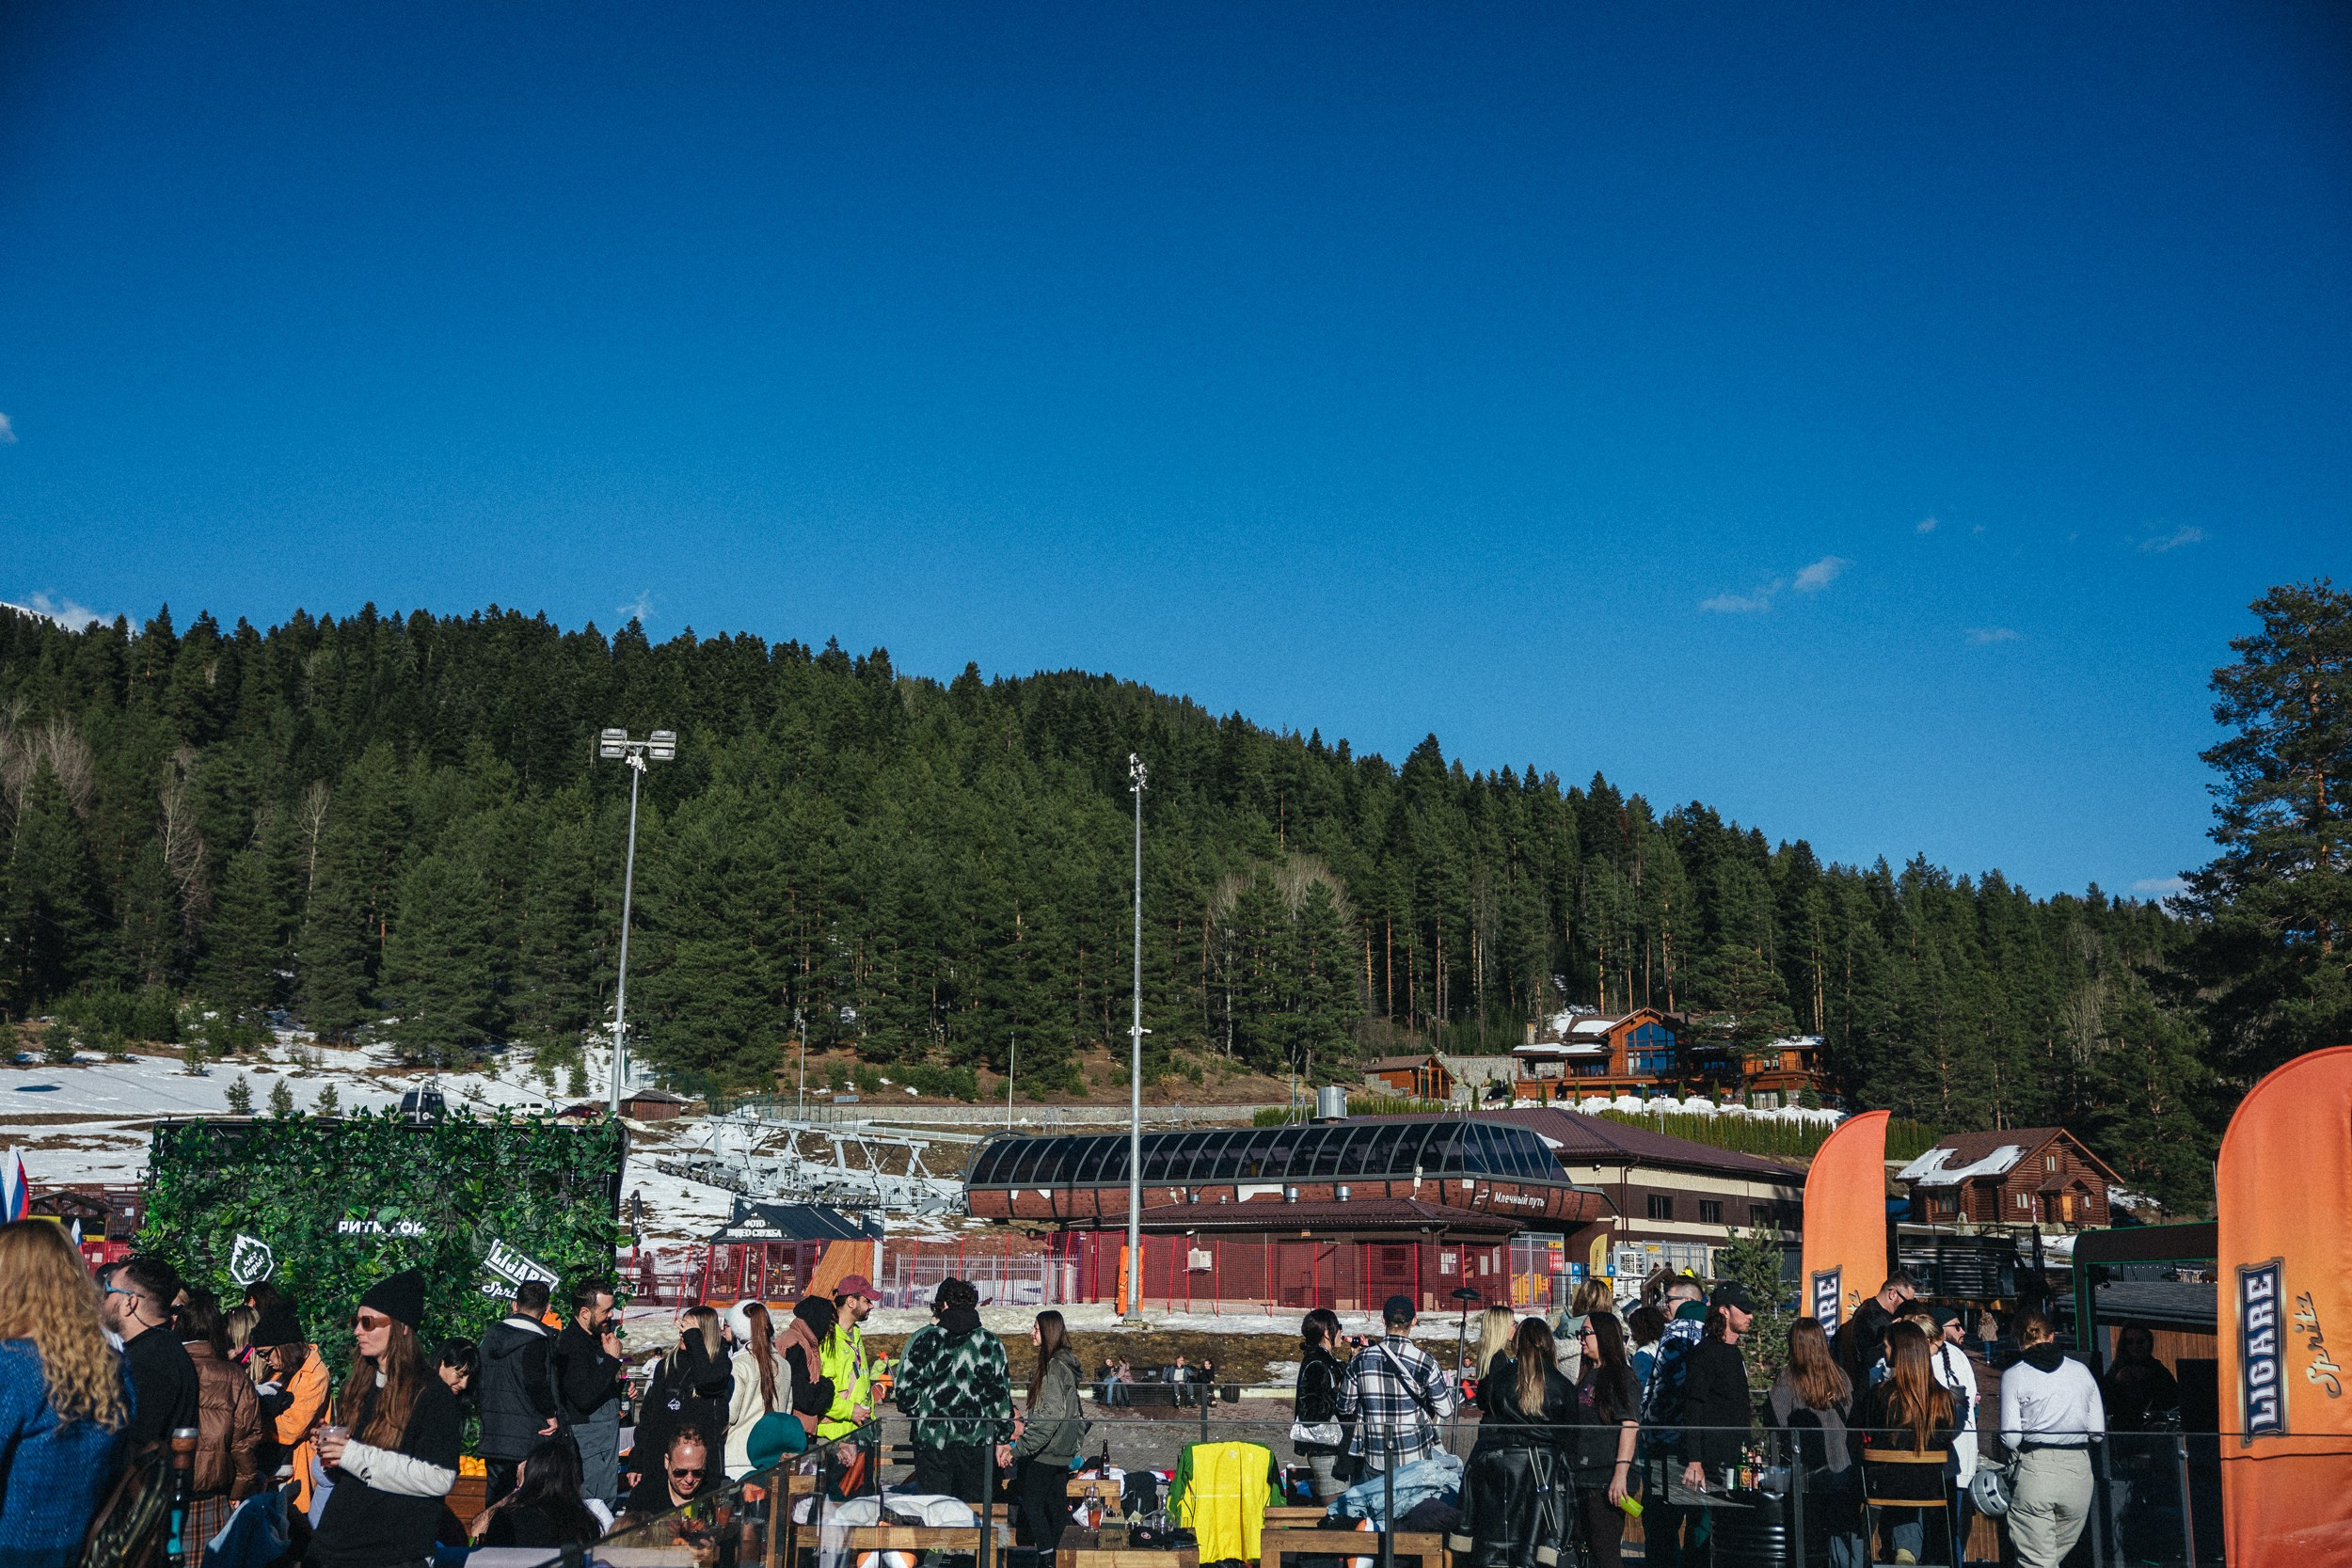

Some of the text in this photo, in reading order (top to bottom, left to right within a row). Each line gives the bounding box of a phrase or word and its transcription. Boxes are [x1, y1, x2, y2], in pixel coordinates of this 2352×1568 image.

[1494, 1192, 1545, 1209] Млечный путь
[743, 1219, 767, 1228] ФОТО
[726, 1228, 783, 1238] ВИДЕО СЛУЖБА
[482, 1281, 518, 1299] Spri
[1817, 1276, 1837, 1337] ARE
[2247, 1273, 2278, 1431] LIGARE
[2294, 1291, 2342, 1399] Spritz
